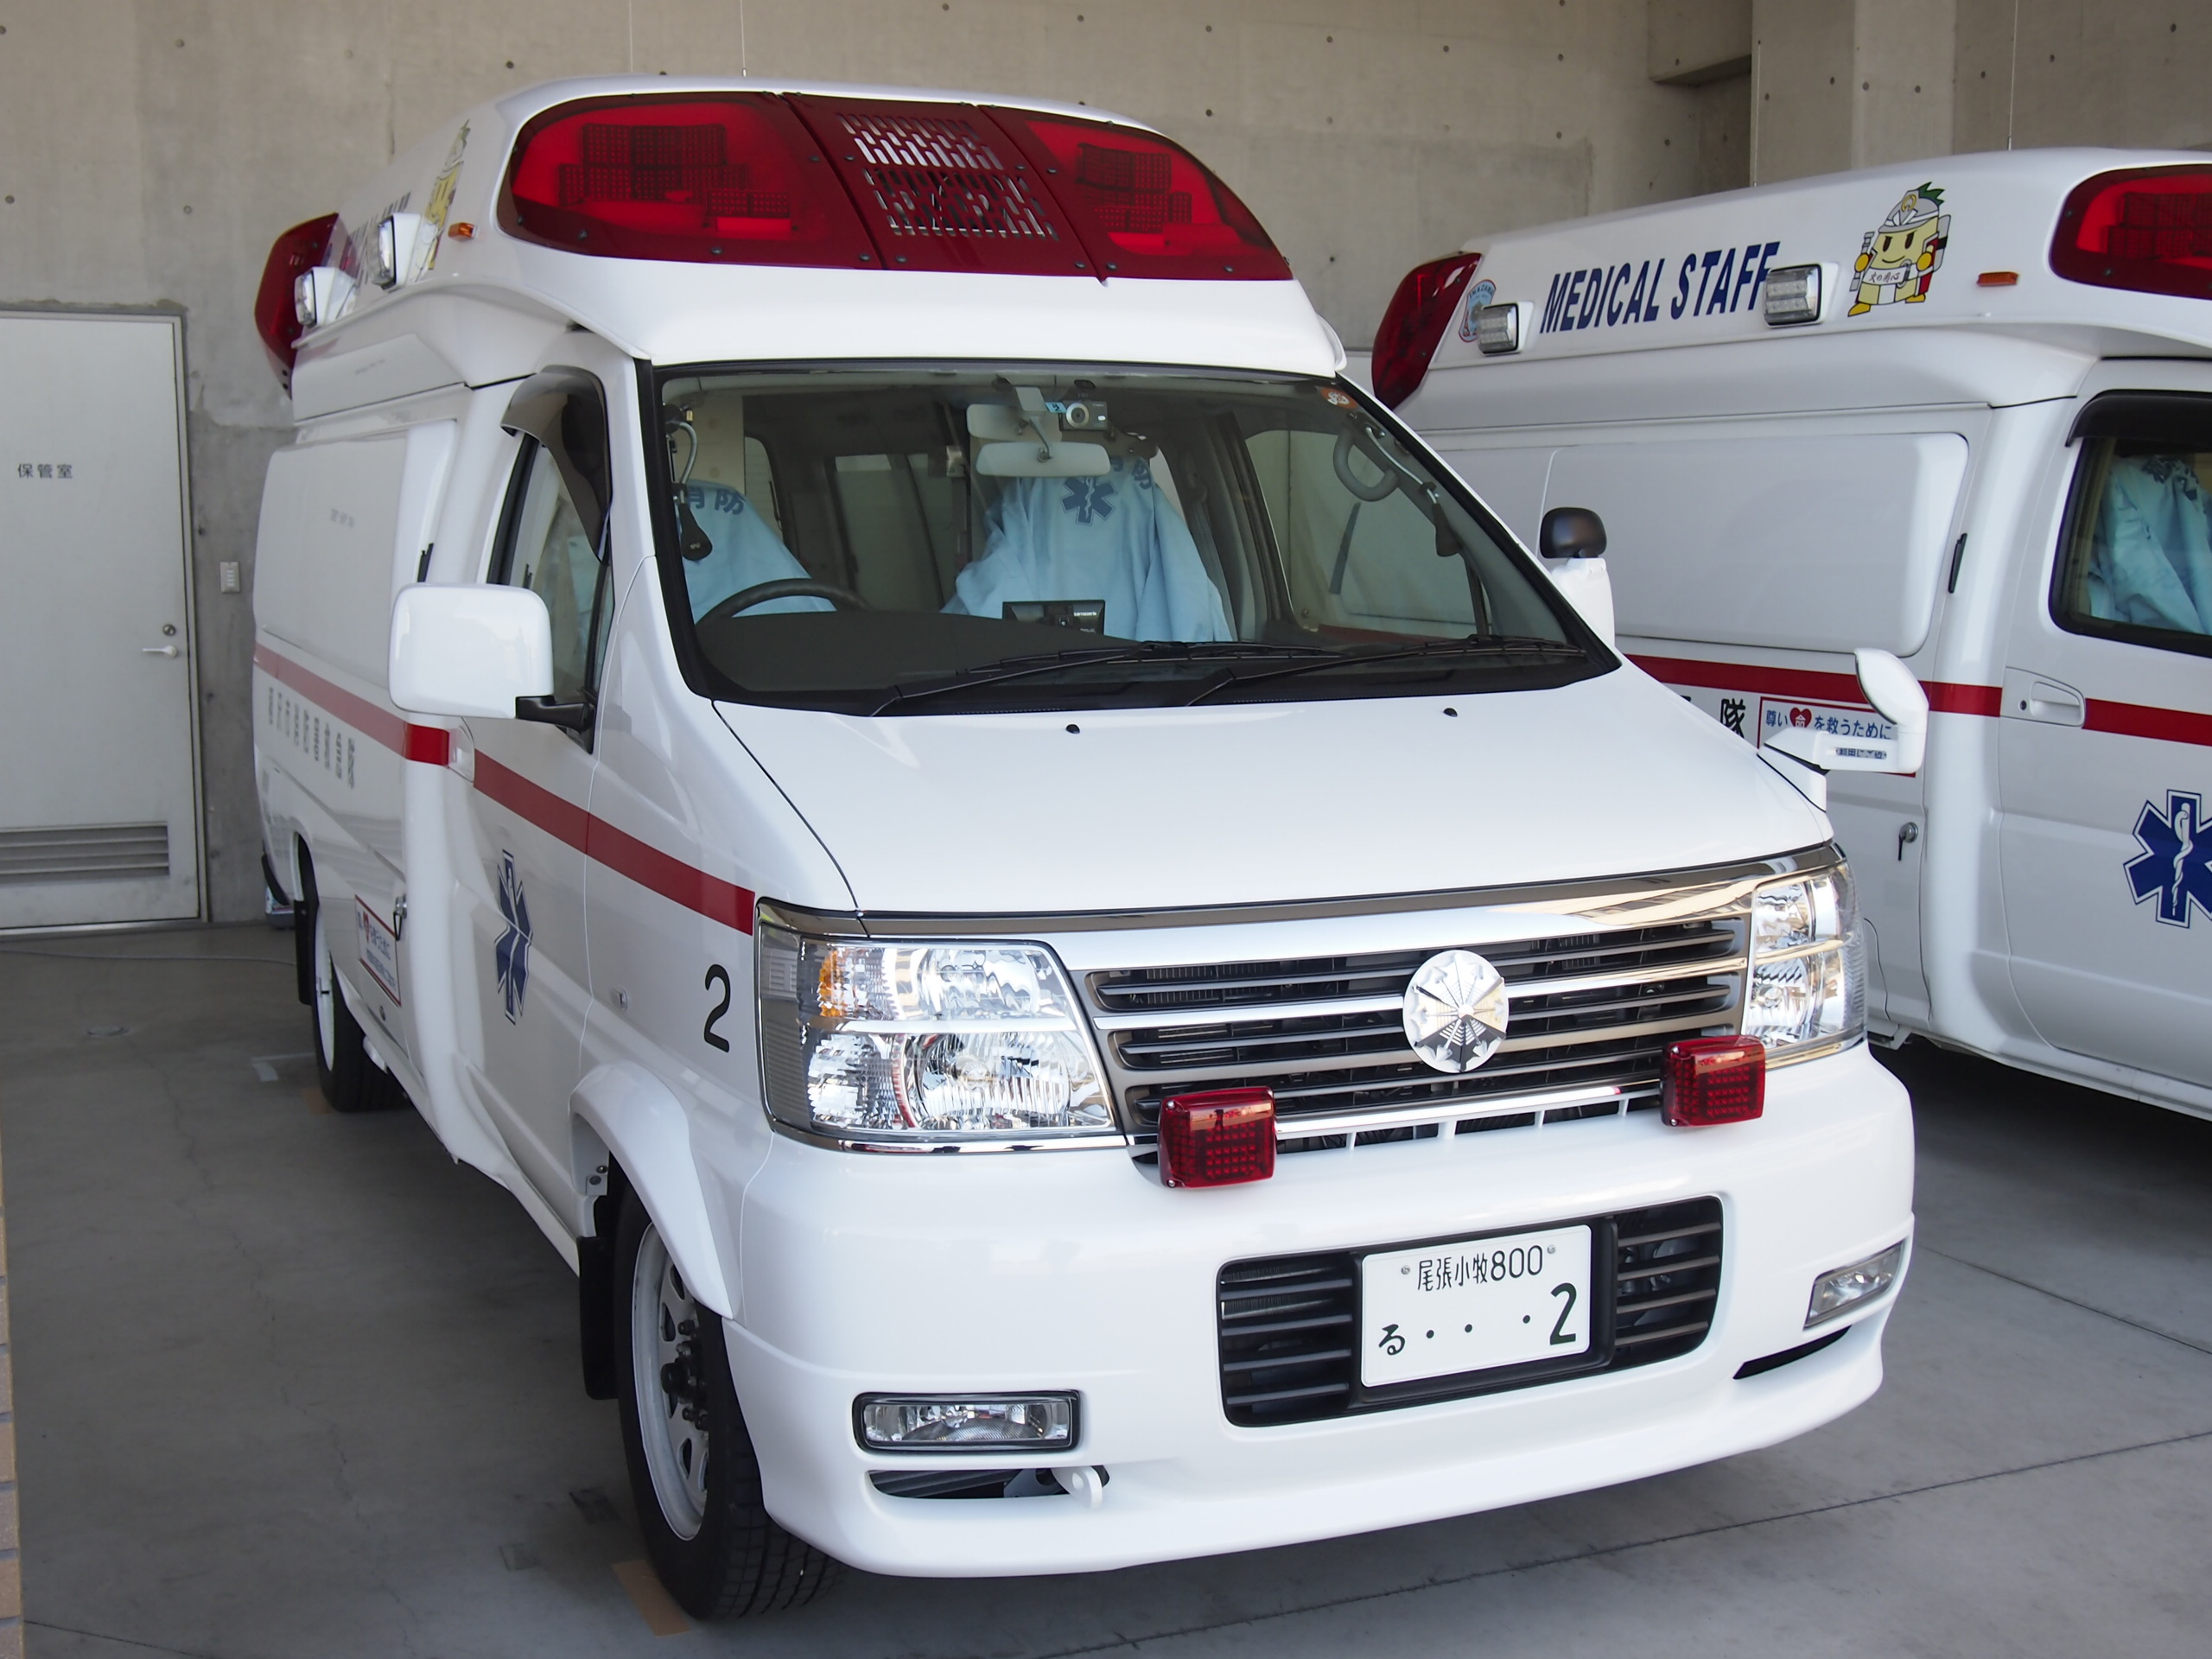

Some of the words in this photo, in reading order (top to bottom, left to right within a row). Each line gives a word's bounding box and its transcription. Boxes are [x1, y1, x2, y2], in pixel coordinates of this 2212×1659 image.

[1540, 258, 1666, 334] MEDICAL
[1670, 241, 1781, 320] STAFF
[17, 463, 73, 479] 保管室
[703, 963, 731, 1053] 2
